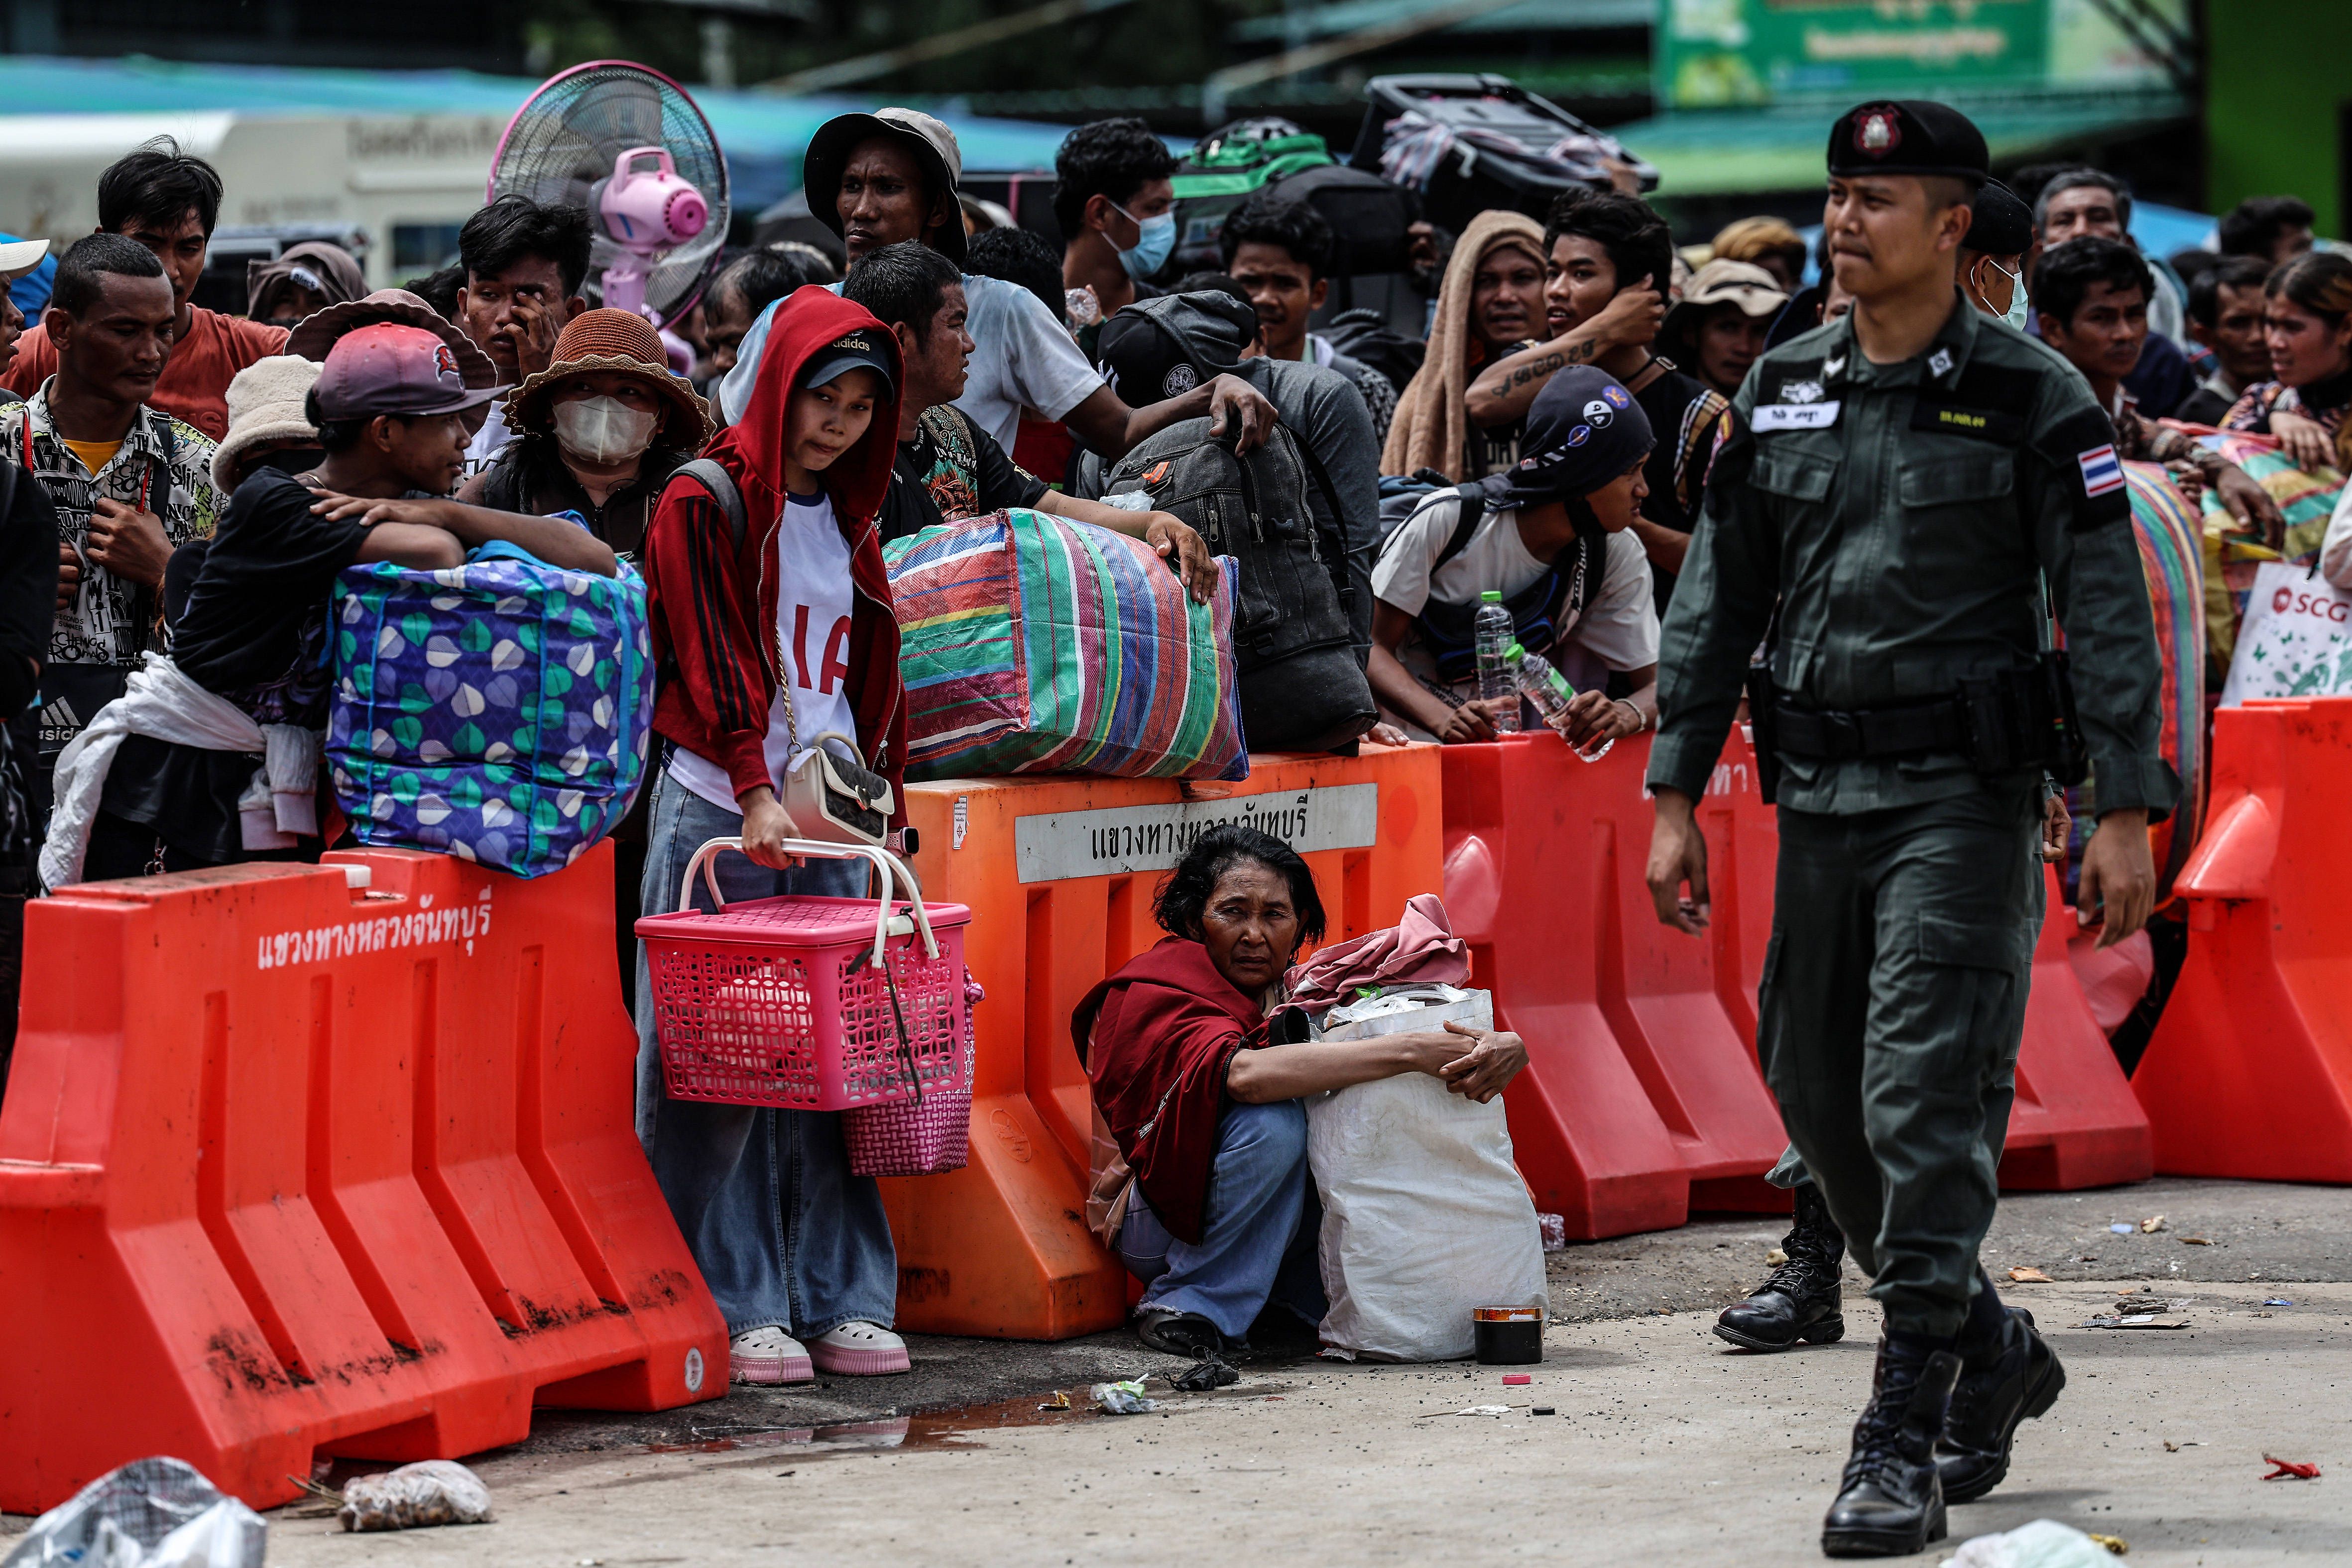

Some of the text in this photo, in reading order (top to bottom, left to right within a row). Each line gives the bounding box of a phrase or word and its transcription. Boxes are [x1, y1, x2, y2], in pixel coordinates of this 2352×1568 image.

[2294, 593, 2350, 622] SCG
[1092, 793, 1308, 860] แขวงทางหันทบุรี
[257, 885, 491, 970] แขวงทางหลวงจันทบุรี
